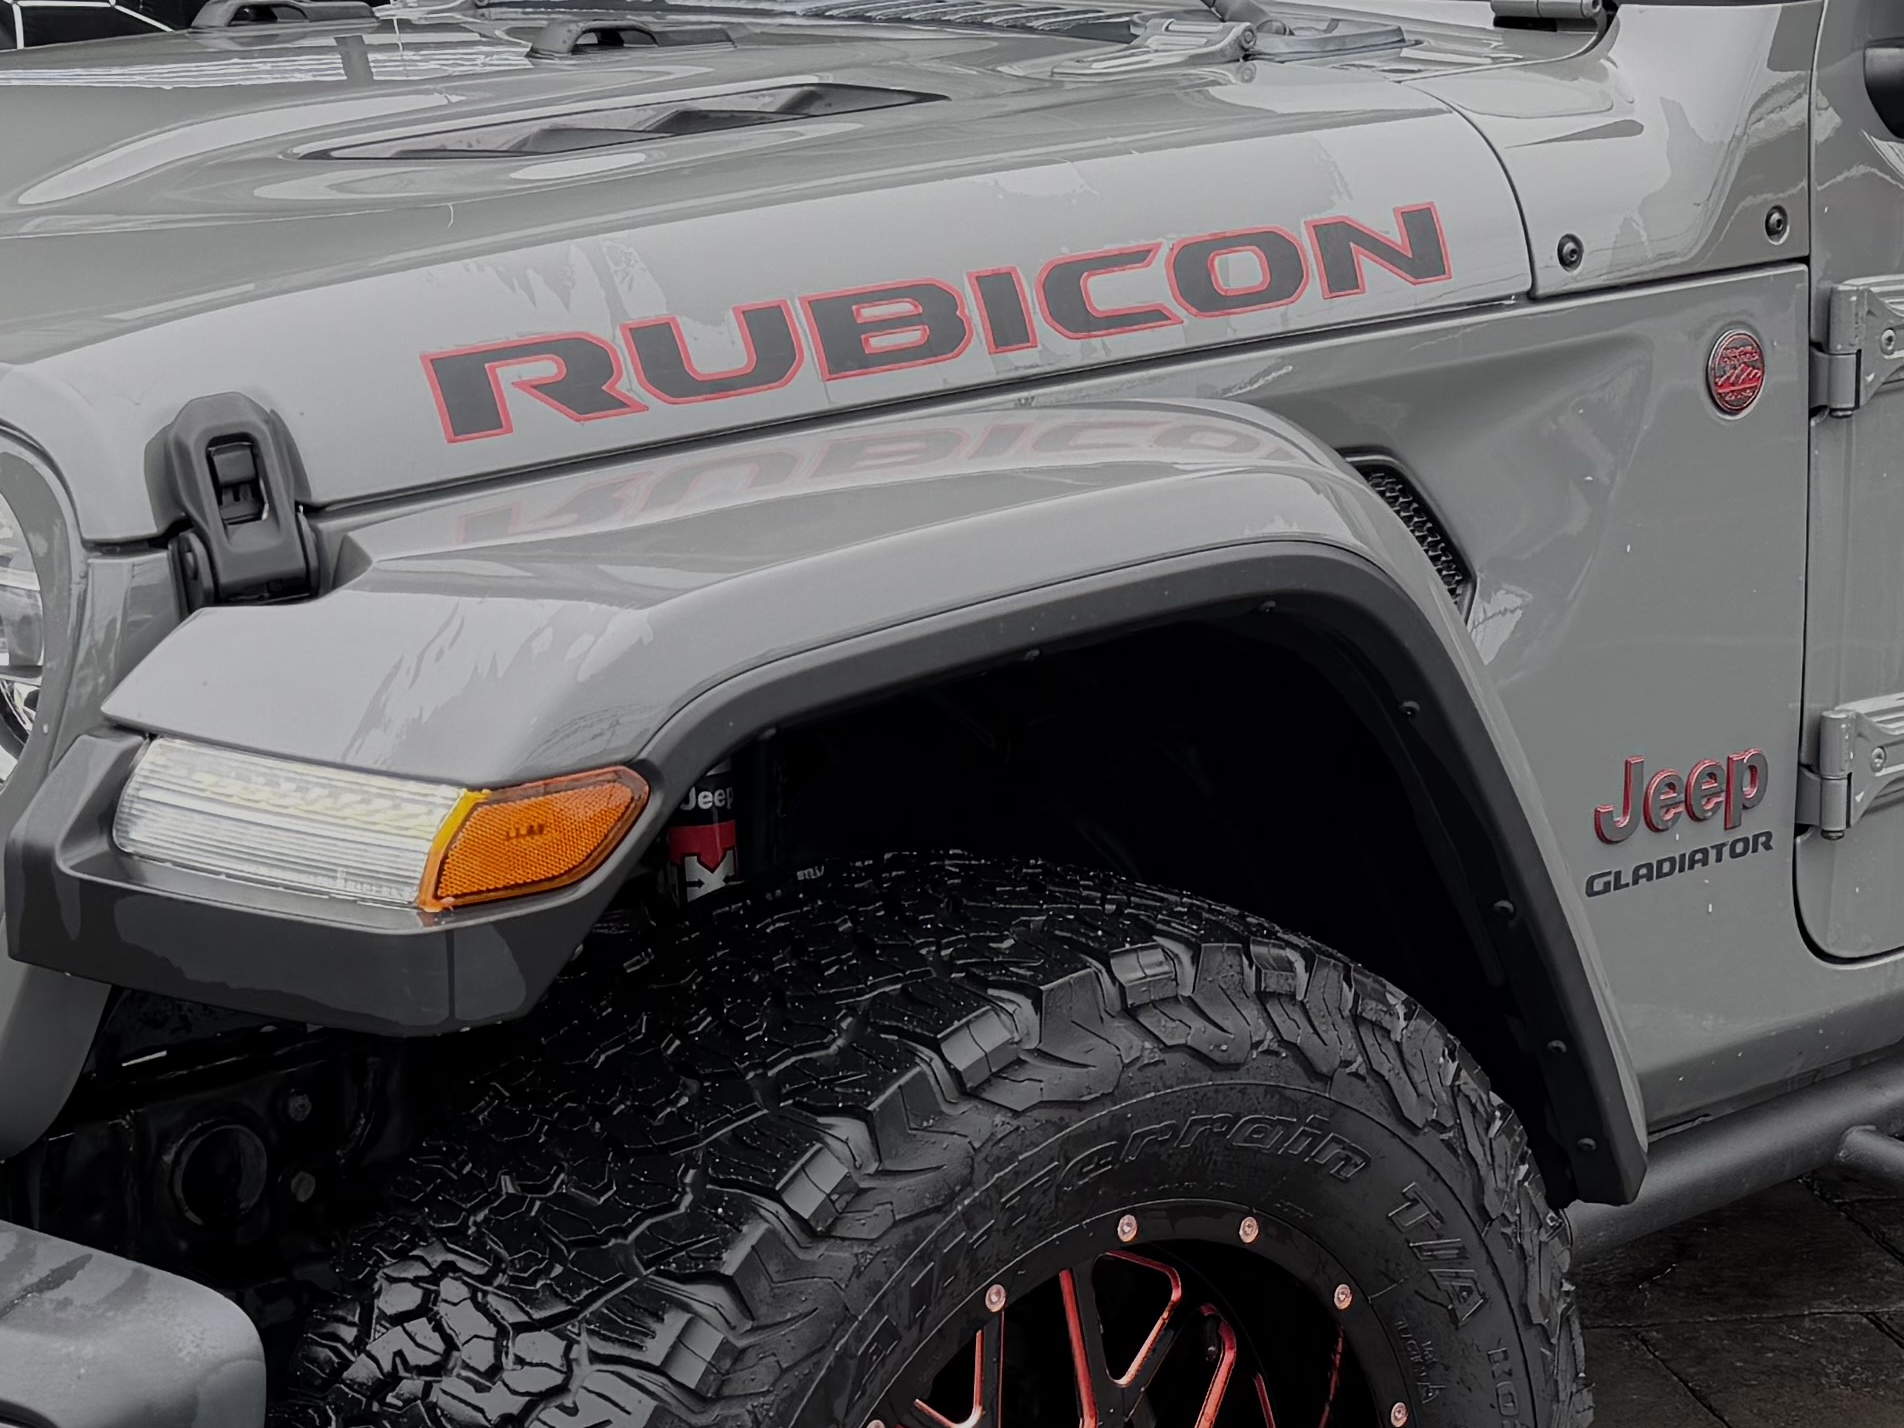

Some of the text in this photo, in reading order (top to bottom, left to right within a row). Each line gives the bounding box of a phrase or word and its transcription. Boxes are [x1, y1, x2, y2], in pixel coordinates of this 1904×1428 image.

[421, 202, 1452, 444] RUBICON
[680, 785, 734, 811] Jeep
[1594, 746, 1768, 845] Jeep
[1584, 829, 1774, 898] GLADIATOR
